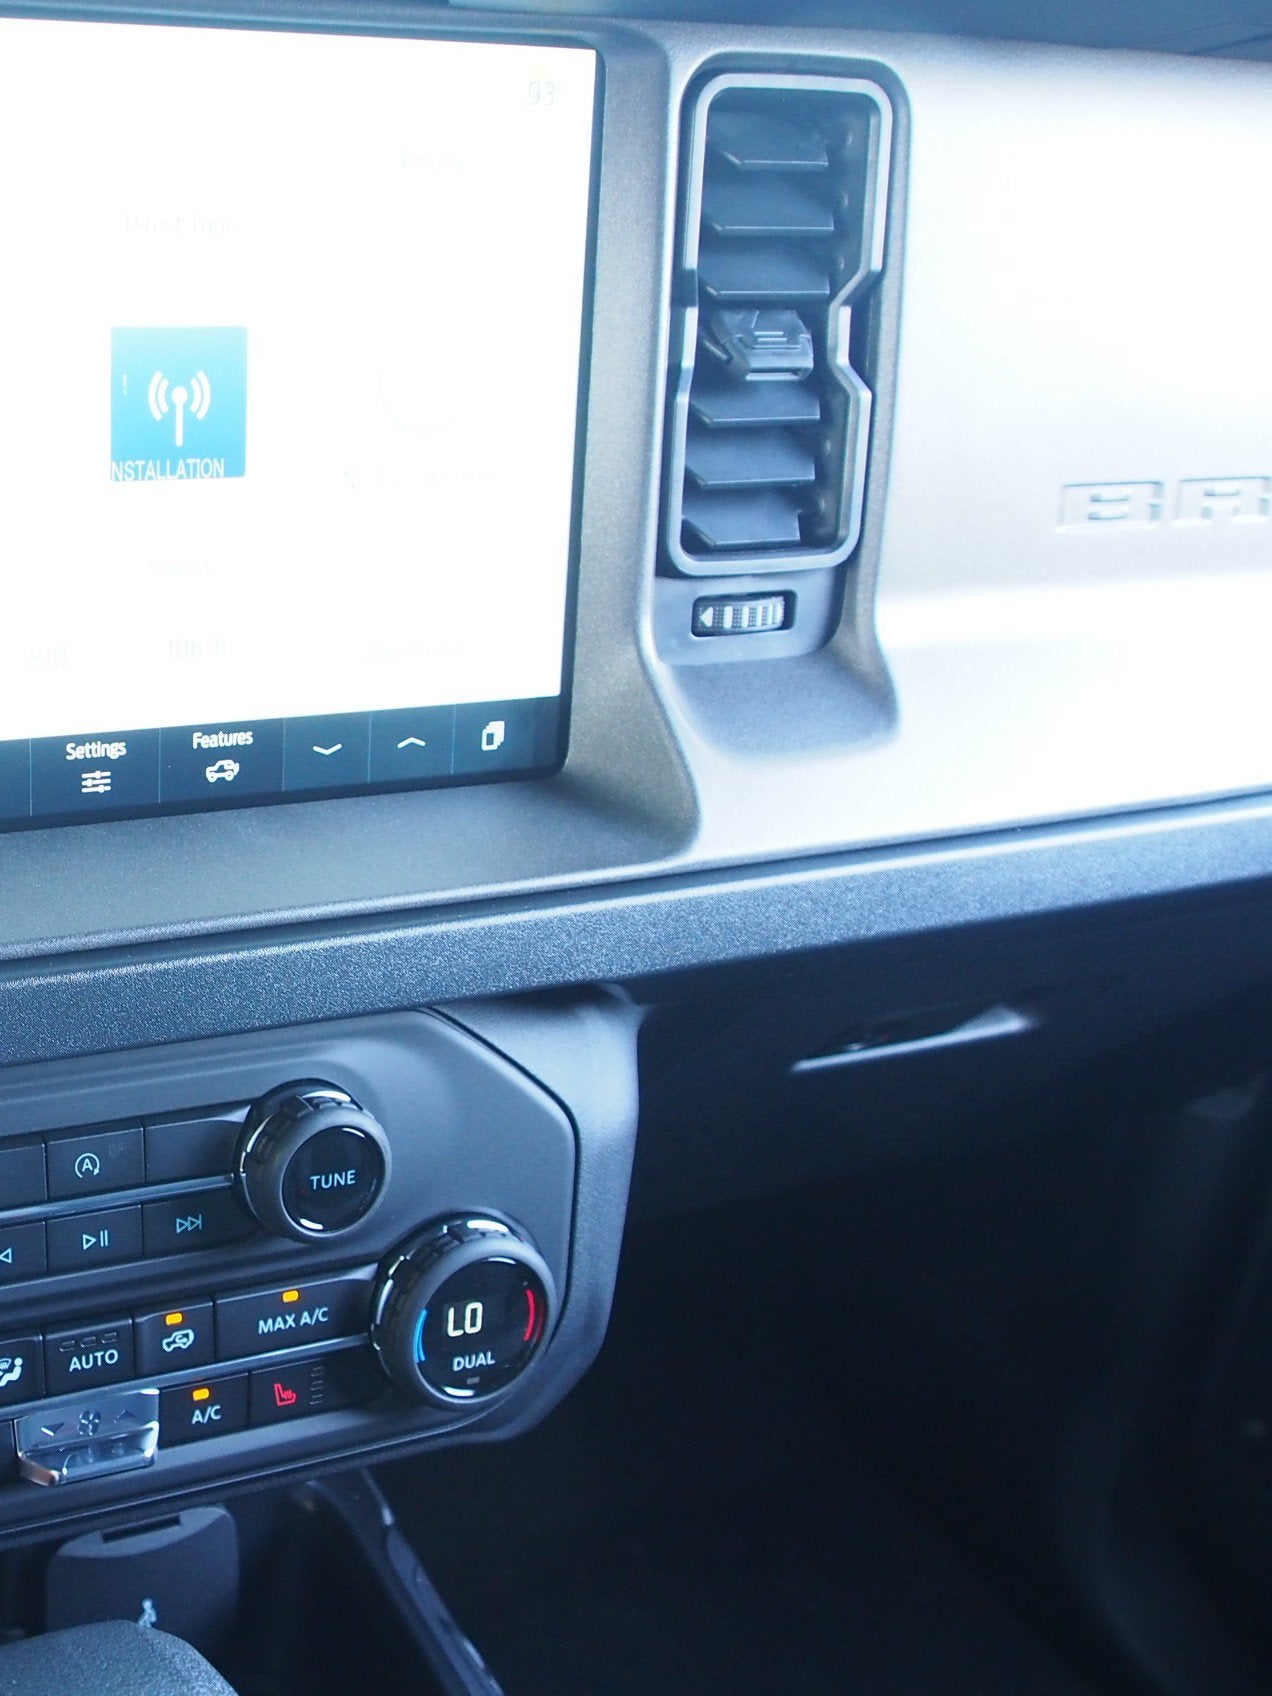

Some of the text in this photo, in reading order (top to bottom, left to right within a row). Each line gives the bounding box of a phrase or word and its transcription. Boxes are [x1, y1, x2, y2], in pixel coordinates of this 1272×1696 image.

[65, 740, 127, 760] Settings
[192, 730, 254, 749] Features
[310, 1169, 356, 1190] TUNE
[258, 1306, 329, 1335] MAX A/C
[446, 1301, 484, 1338] LO
[68, 1348, 119, 1373] AUTO
[452, 1350, 496, 1372] DUAL
[191, 1404, 222, 1425] A/C
